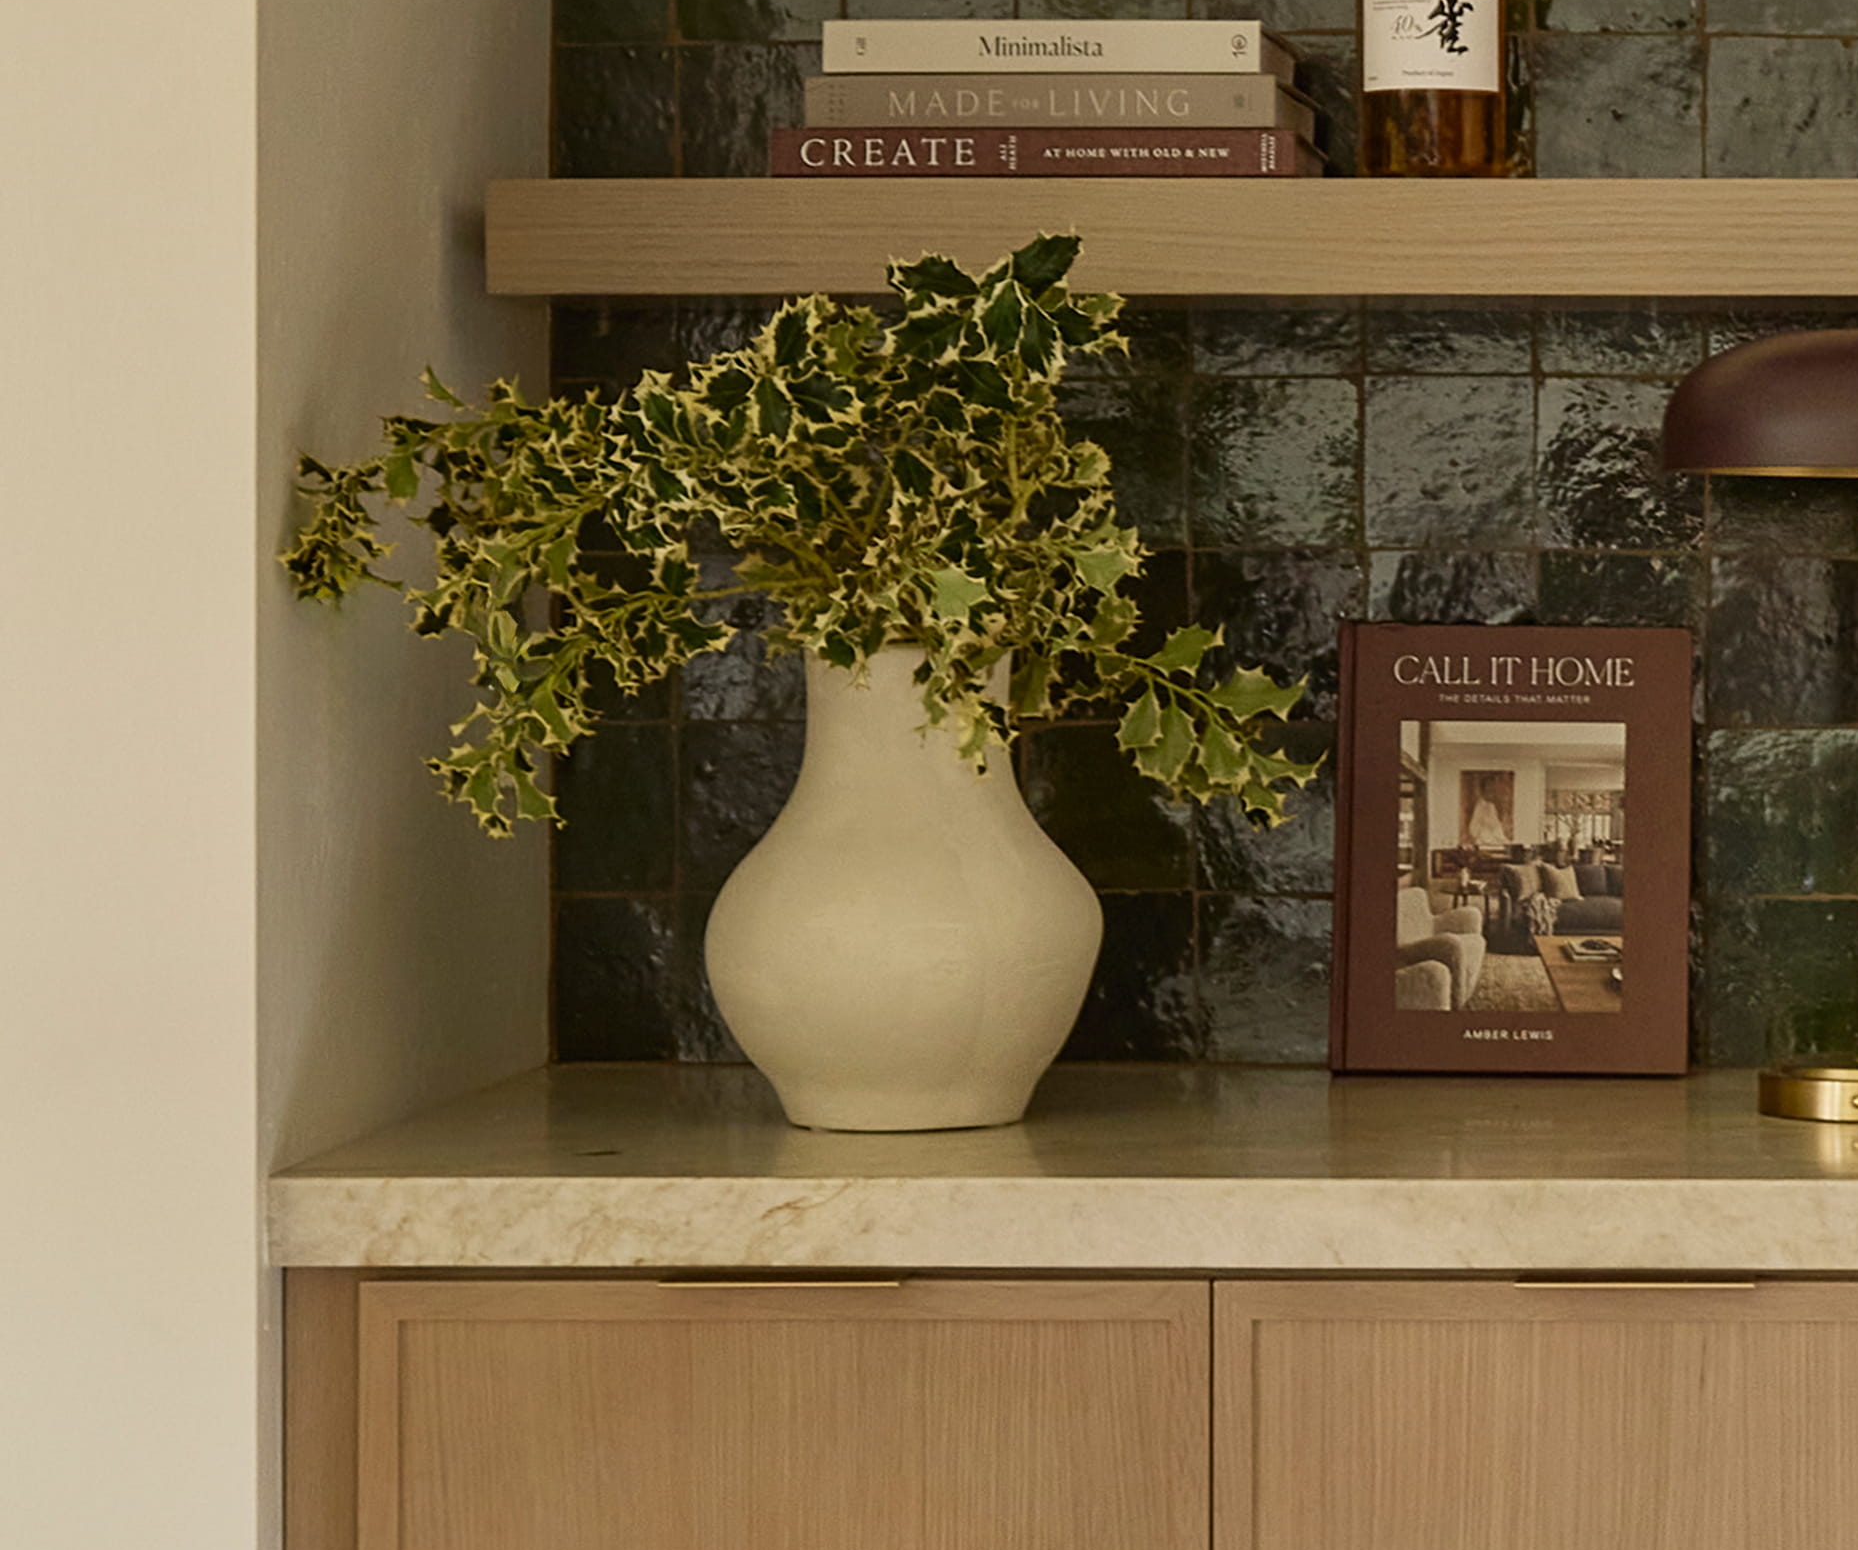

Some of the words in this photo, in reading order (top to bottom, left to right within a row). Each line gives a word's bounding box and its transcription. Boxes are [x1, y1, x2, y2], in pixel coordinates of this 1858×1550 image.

[978, 35, 1103, 58] Minimalista
[888, 90, 1005, 117] MADE
[1050, 89, 1190, 117] LIVING
[800, 137, 976, 167] CREATE
[1043, 147, 1061, 158] AT
[1065, 147, 1105, 159] HOME
[1109, 147, 1150, 158] WITH
[1152, 147, 1181, 158] OLD
[1184, 148, 1194, 158] &
[1197, 147, 1231, 158] NEW
[1393, 654, 1481, 686] CALL
[1491, 656, 1522, 686] IT
[1531, 655, 1636, 687] HOME
[1439, 693, 1460, 704] THE
[1463, 693, 1511, 704] DETAILS
[1515, 693, 1542, 704] THAT
[1546, 693, 1591, 705] MATTER
[1463, 1029, 1509, 1041] AMBER
[1512, 1029, 1554, 1041] LEWIS
